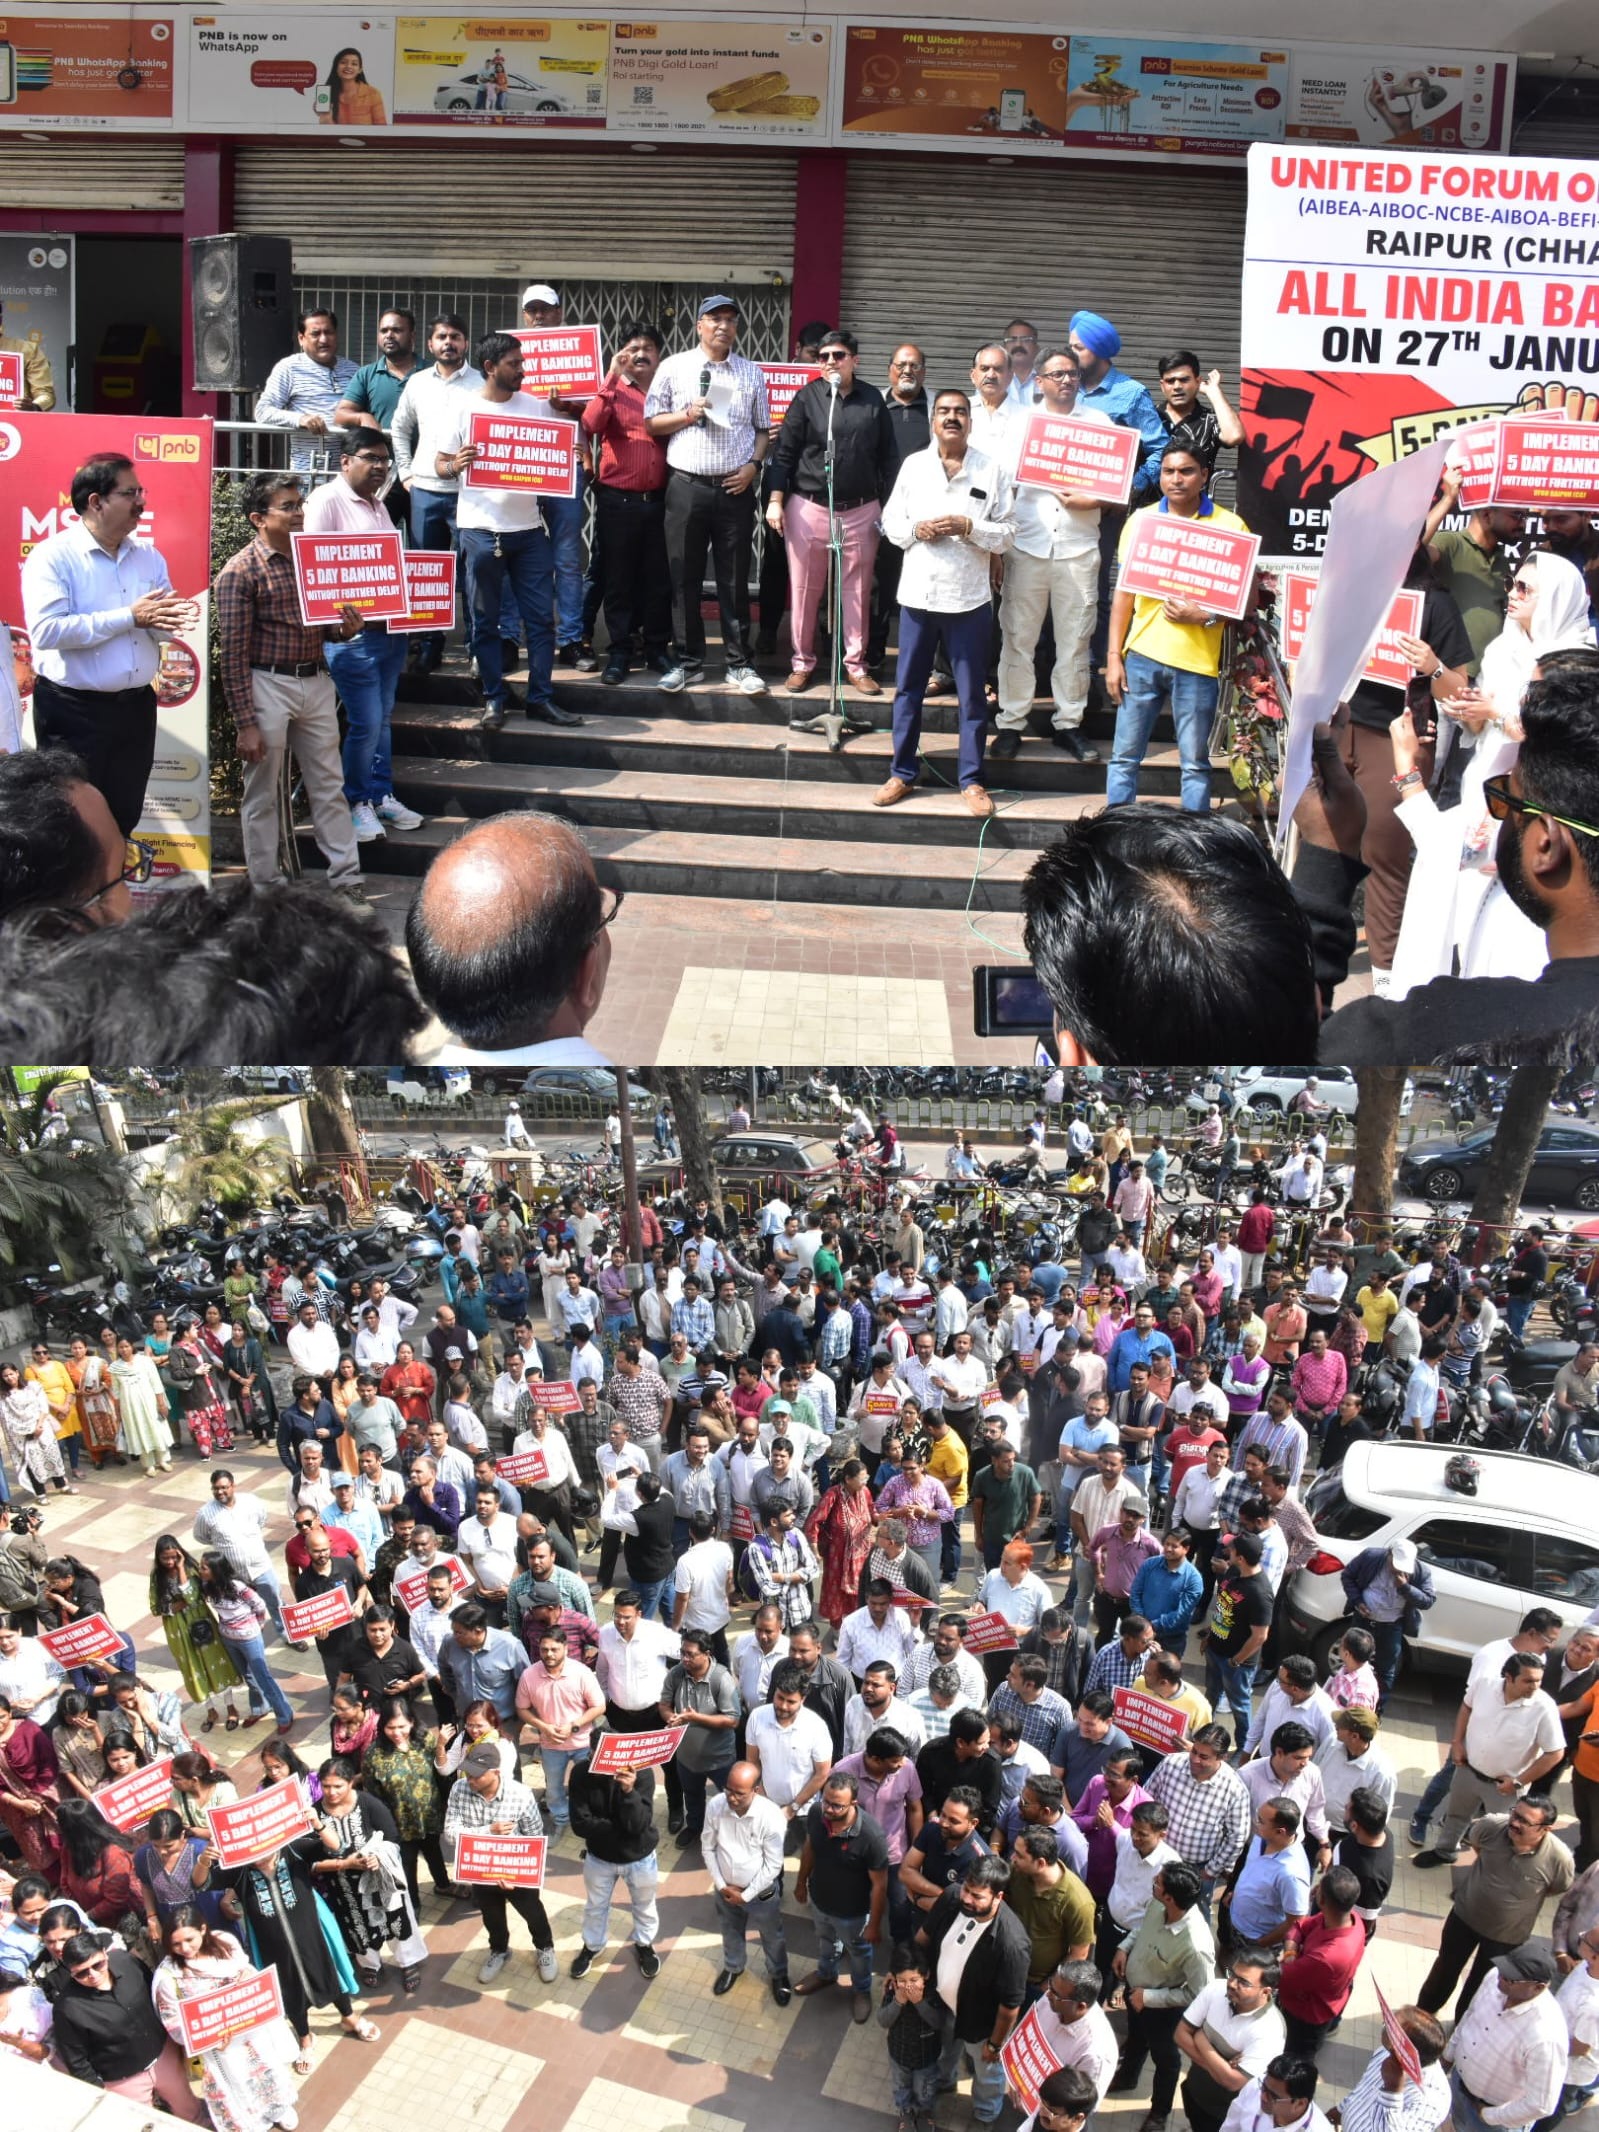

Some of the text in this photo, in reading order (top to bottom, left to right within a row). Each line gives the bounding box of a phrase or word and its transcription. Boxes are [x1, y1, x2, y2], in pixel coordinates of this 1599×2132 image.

[199, 31, 288, 41] PNB is now on
[633, 25, 656, 37] pnb
[199, 42, 259, 54] WhatsApp
[903, 34, 924, 44] PNB
[927, 35, 978, 47] WhatsApp
[615, 46, 780, 58] Turn your gold into instant funds
[917, 45, 934, 54] has
[937, 46, 955, 56] just
[54, 57, 74, 66] PNB
[77, 57, 126, 68] WhatsApp
[613, 59, 635, 68] PNB
[637, 59, 659, 70] Digi
[661, 60, 687, 69] Gold
[1143, 60, 1168, 73] pnb
[68, 68, 104, 78] has just
[630, 72, 664, 82] starting
[1177, 80, 1219, 90] Agriculture
[1221, 83, 1243, 91] Needs
[1302, 79, 1346, 88] NEED LOAN
[1301, 87, 1347, 97] INSTANTLY?
[1270, 156, 1559, 204] UNITED FORUM
[1366, 229, 1492, 261] RAIPUR
[1276, 270, 1367, 318] ALL
[1385, 275, 1525, 326] INDIA
[520, 337, 580, 354] MPLEMENT
[1322, 326, 1382, 364] ON
[540, 355, 592, 371] BANKING
[763, 372, 809, 386] PLEMENT
[489, 423, 559, 444] IMPLEMENT
[1044, 423, 1117, 450] IMPLEMENT
[163, 438, 196, 459] pnb
[476, 442, 568, 464] 5 DAY BANKING
[1030, 440, 1124, 471] 5 DAY BANKING
[473, 461, 569, 478] WITHOUT FURTHER DELAY
[1507, 454, 1551, 473] 5 DAY
[1501, 475, 1592, 490] WITHOUT FURTHER
[22, 506, 155, 547] MSE
[1154, 525, 1235, 557] IMPLEMENT
[314, 543, 383, 562] IMPLEMENT
[1136, 542, 1242, 581] 5 DAY BANKING
[305, 565, 397, 585] 5 DAY BANKING
[306, 585, 400, 601] WITHOUT FURTHER DELAY
[414, 582, 449, 597] BANKING
[162, 839, 197, 849] Financing
[1124, 1708, 1142, 1721] DAY
[1127, 1696, 1174, 1723] IMPLEMENT
[616, 1734, 671, 1749] IMPLEMENT
[603, 1742, 674, 1759] 5 DAY BANKING
[226, 1790, 287, 1825] IMPLEMENT
[220, 1801, 300, 1842] 5 DAY BANKING
[473, 1841, 530, 1854] IMPLEMENT
[463, 1852, 537, 1867] 5 DAY BANKING
[197, 1980, 261, 2014] IMPLEMENT
[190, 1989, 274, 2032] 5 DAY BANKING
